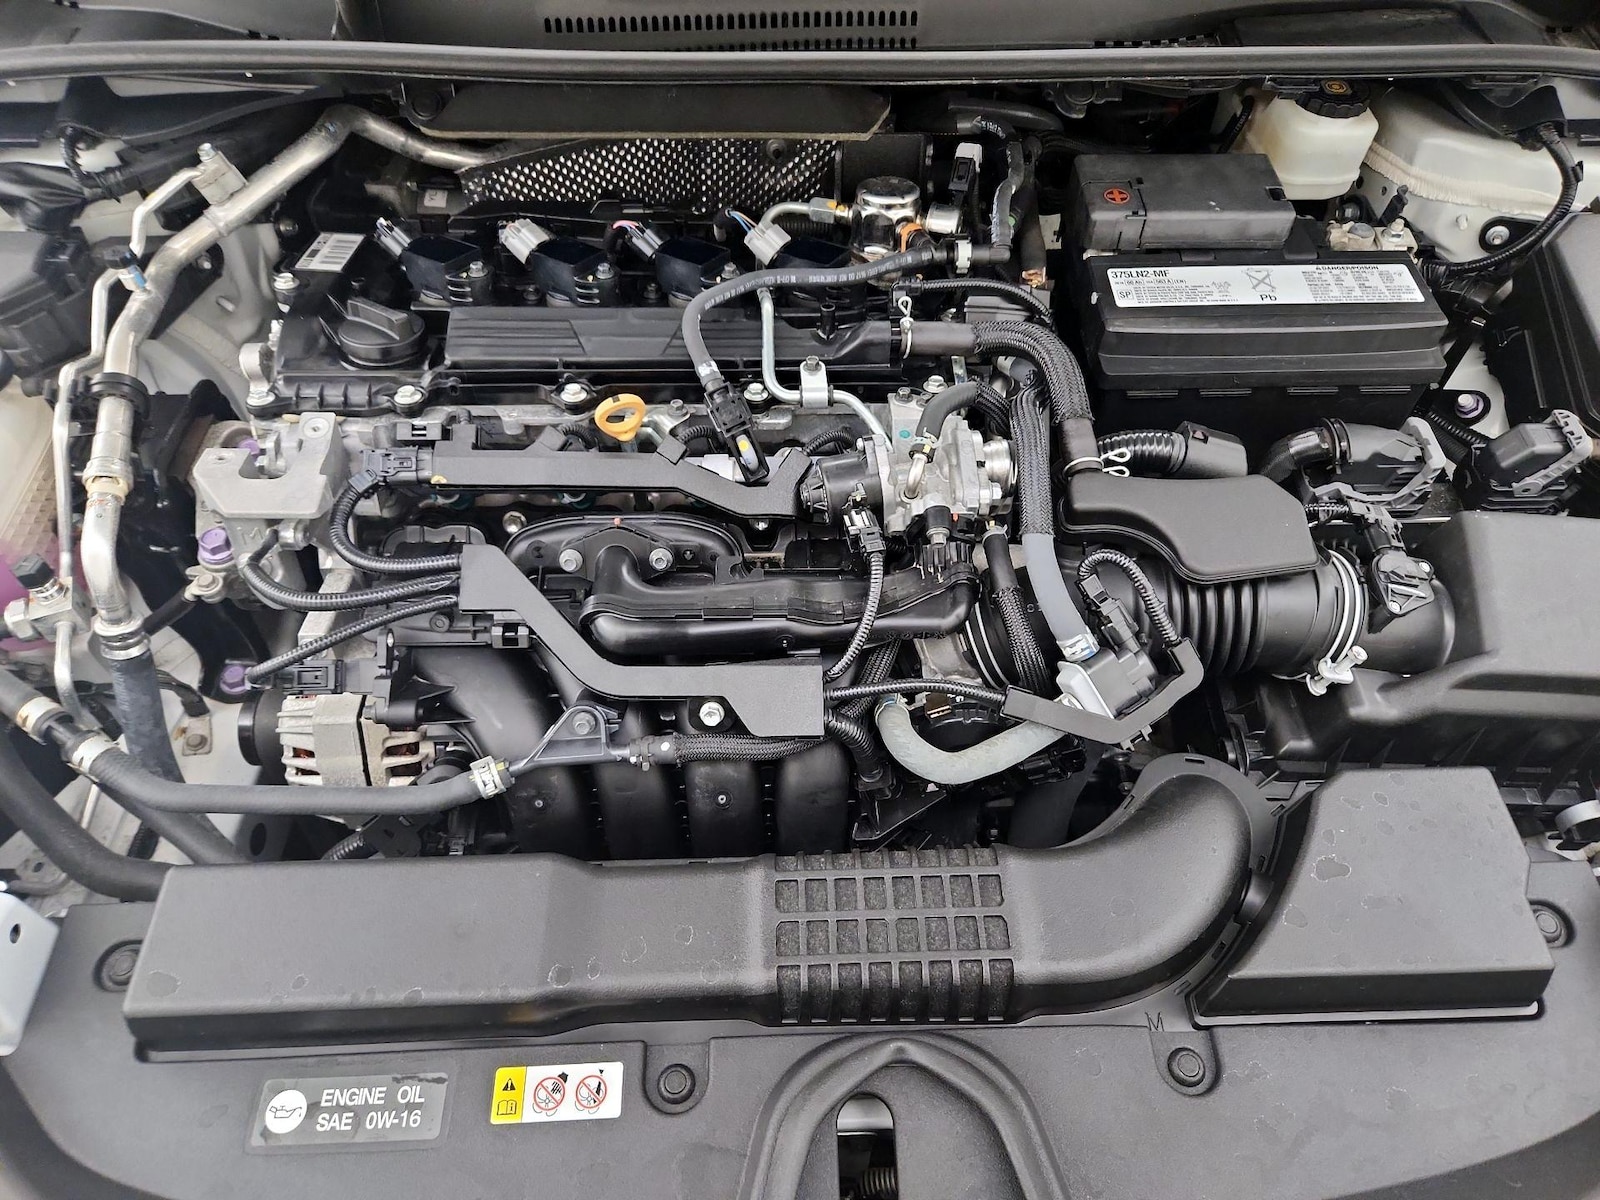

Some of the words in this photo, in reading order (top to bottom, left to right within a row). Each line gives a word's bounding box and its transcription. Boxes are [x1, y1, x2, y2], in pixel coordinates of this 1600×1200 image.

[1111, 269, 1170, 279] 375LN2-MF
[1119, 291, 1131, 299] SP
[320, 1086, 387, 1107] ENGINE
[397, 1085, 425, 1104] OIL
[316, 1112, 354, 1132] SAE
[365, 1110, 422, 1130] 0W-16
